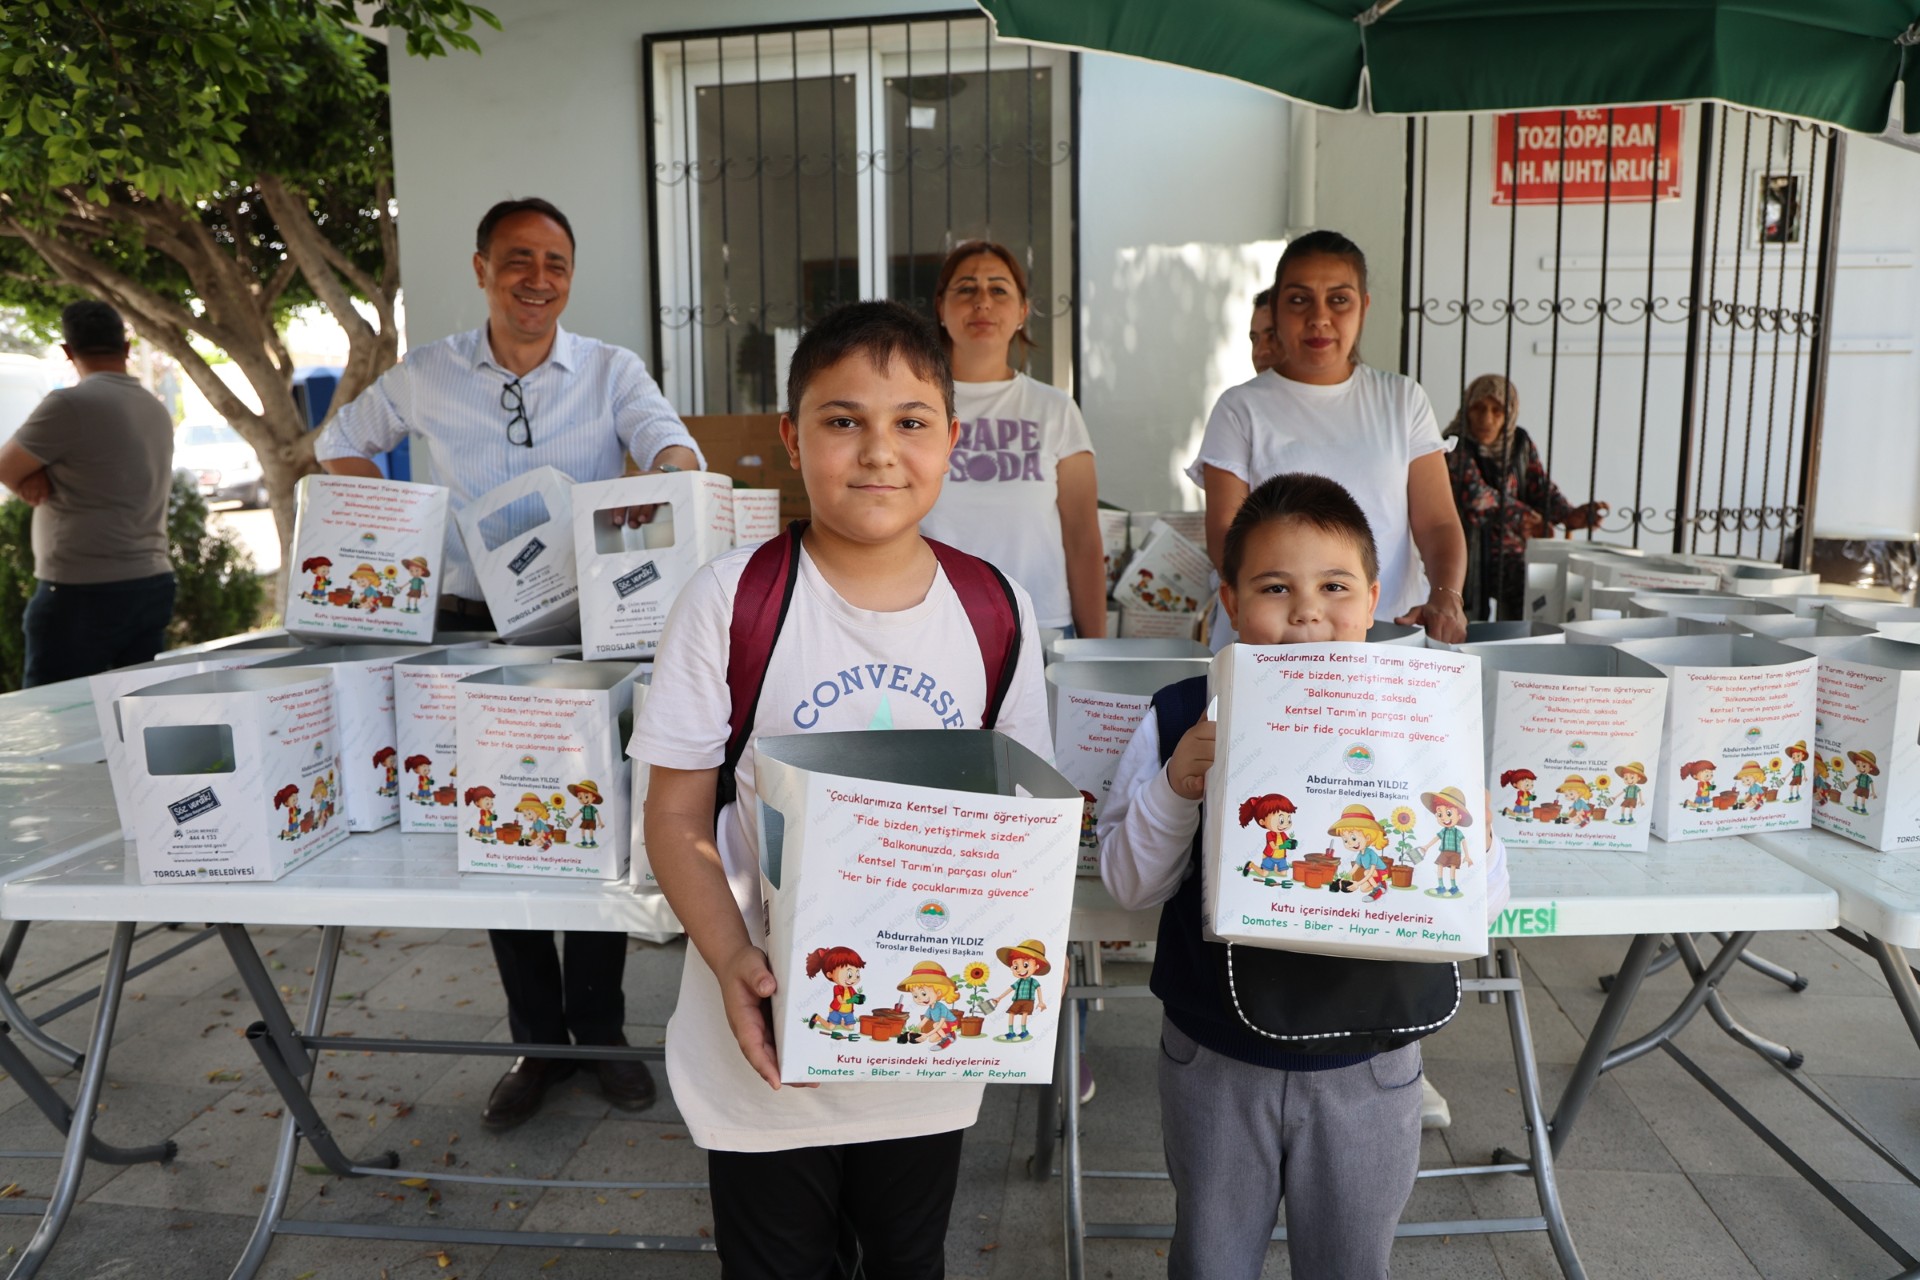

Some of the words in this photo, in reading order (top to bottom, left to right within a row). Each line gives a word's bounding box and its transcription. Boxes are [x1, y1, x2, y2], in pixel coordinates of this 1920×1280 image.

[1518, 124, 1657, 150] TOZKOPARAN
[954, 418, 1040, 451] RAPE
[507, 604, 541, 624] TOROSLAR
[596, 643, 636, 653] TOROSLAR
[1328, 652, 1368, 663] Kentsel
[1372, 655, 1404, 667] Tarımı
[1308, 671, 1344, 682] bizden,
[1346, 673, 1403, 685] yetiştirmek
[793, 664, 964, 730] CONVERSE
[1380, 691, 1416, 704] saksıda
[1284, 704, 1322, 715] Kentsel
[1370, 710, 1406, 721] parçası
[1294, 724, 1308, 732] bir
[1312, 722, 1334, 734] fide
[1338, 726, 1404, 739] çocuklarımıza
[1306, 774, 1374, 787] Abdurrahman
[1376, 779, 1408, 789] YILDIZ
[1304, 786, 1337, 794] Toroslar
[1338, 788, 1378, 798] Belediyesi
[1378, 791, 1408, 800] Başkanı
[906, 801, 948, 814] Kentsel
[952, 805, 988, 819] Tarımı
[883, 820, 920, 834] bizden,
[924, 825, 986, 839] yetiştirmek
[960, 847, 999, 860] saksıda
[153, 870, 196, 878] TOROSLAR
[209, 866, 255, 877] BELEDİYESİ
[856, 853, 896, 867] Kentsel
[946, 866, 986, 878] parçası
[866, 874, 882, 885] bir
[884, 876, 907, 889] fide
[910, 882, 984, 896] çocuklarımıza
[1270, 902, 1295, 913] Kutu
[1300, 904, 1360, 918] içerisindeki
[1364, 909, 1433, 924] hediyeleriniz
[1242, 914, 1288, 927] Domates
[1304, 919, 1333, 930] Biber
[1348, 924, 1380, 936] Hıyar
[1395, 927, 1418, 938] Mor
[1421, 928, 1461, 941] Reyhan
[875, 929, 948, 944] Abdurrahman
[950, 936, 984, 946] YILDIZ
[874, 941, 908, 951] Toroslar
[908, 944, 950, 955] Belediyesi
[952, 948, 984, 956] Başkanı
[836, 1054, 862, 1065] Kutu
[866, 1056, 928, 1066] içerisindeki
[930, 1055, 1000, 1067] hediyeleriniz
[806, 1066, 856, 1076] Domates
[870, 1066, 900, 1077] Biber
[916, 1069, 946, 1078] Hıyar
[962, 1068, 984, 1078] Mor
[988, 1068, 1026, 1079] Reyhan
